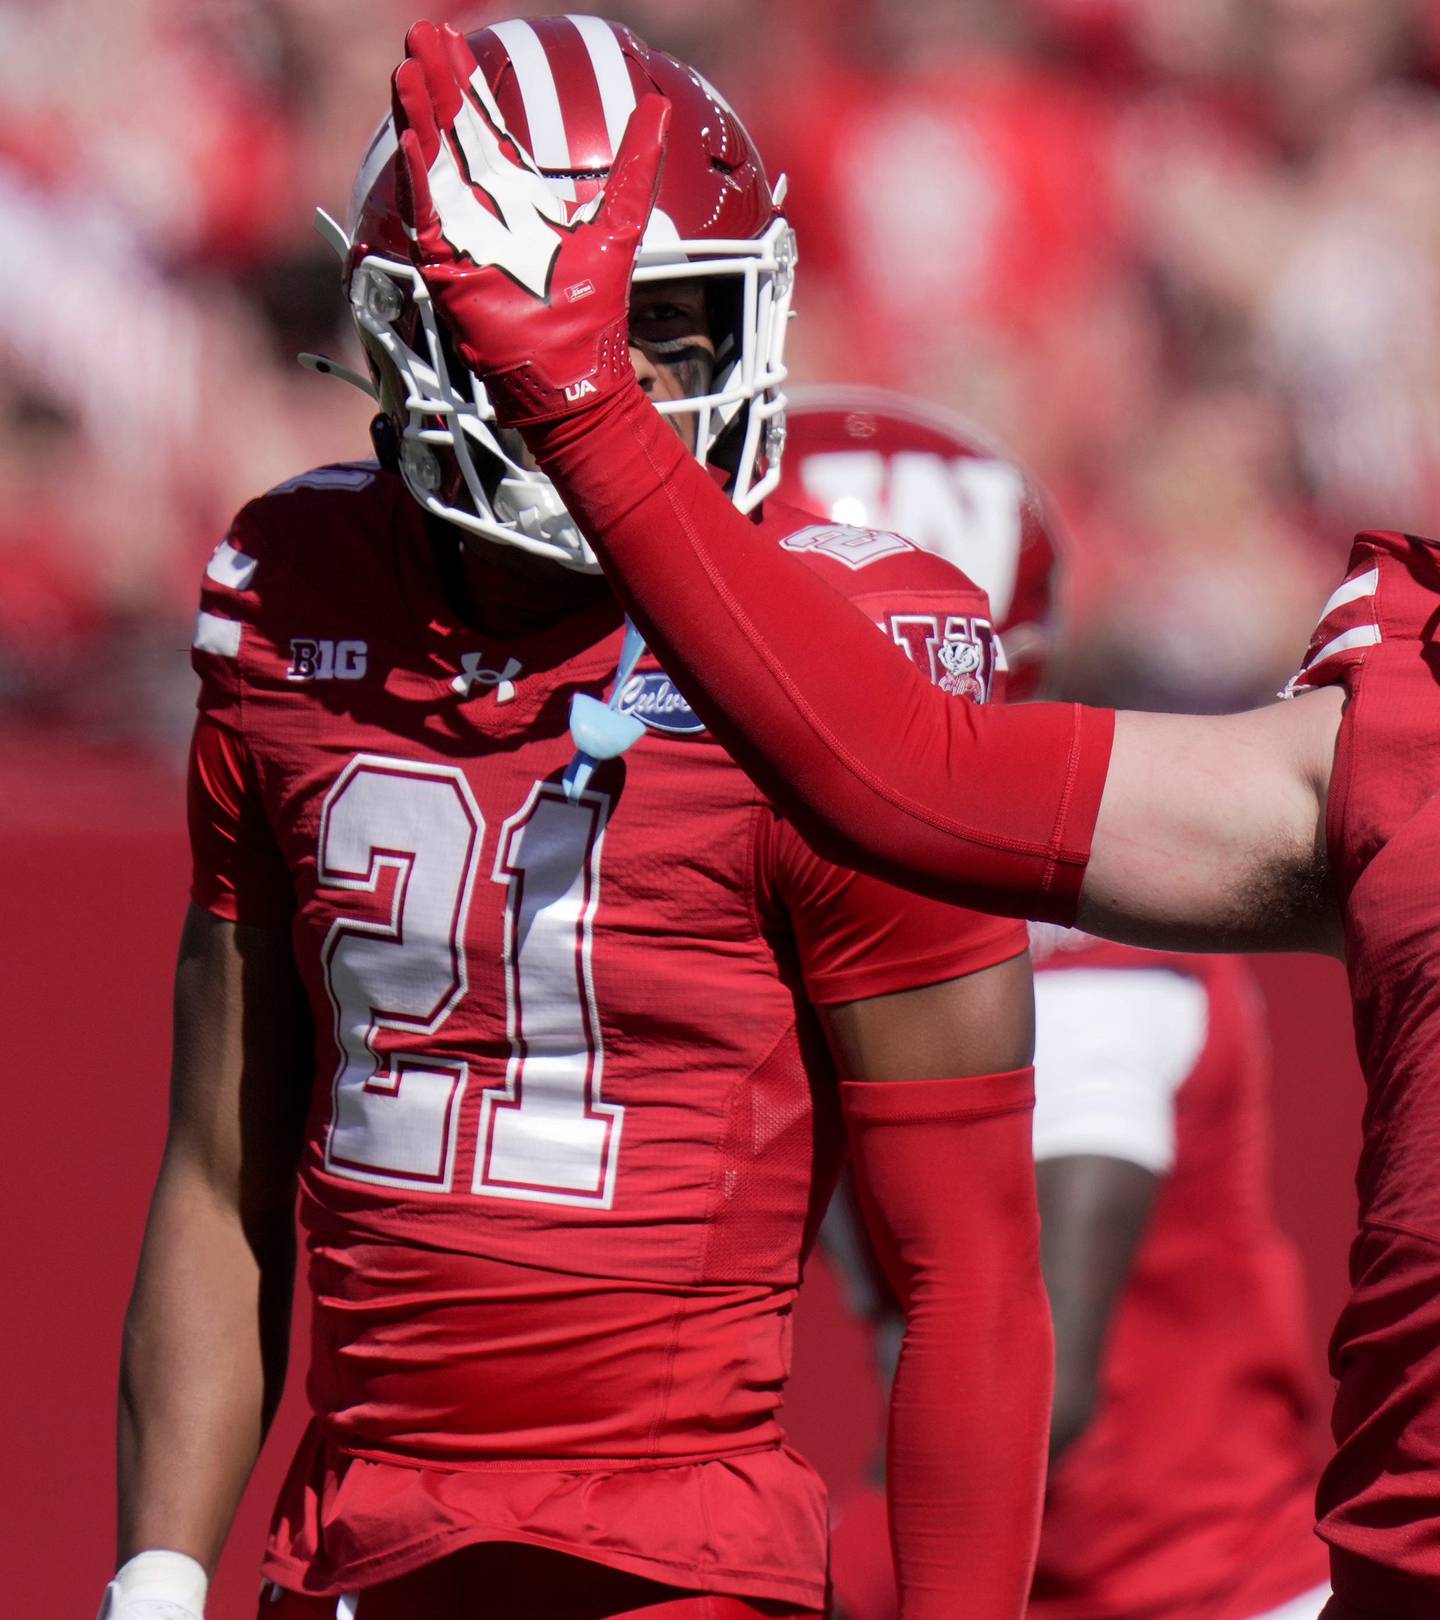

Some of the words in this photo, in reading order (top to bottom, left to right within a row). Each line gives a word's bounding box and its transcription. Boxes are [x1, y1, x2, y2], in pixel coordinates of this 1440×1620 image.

[565, 380, 597, 401] UA
[618, 675, 692, 715] Culv
[318, 753, 625, 1210] 21
